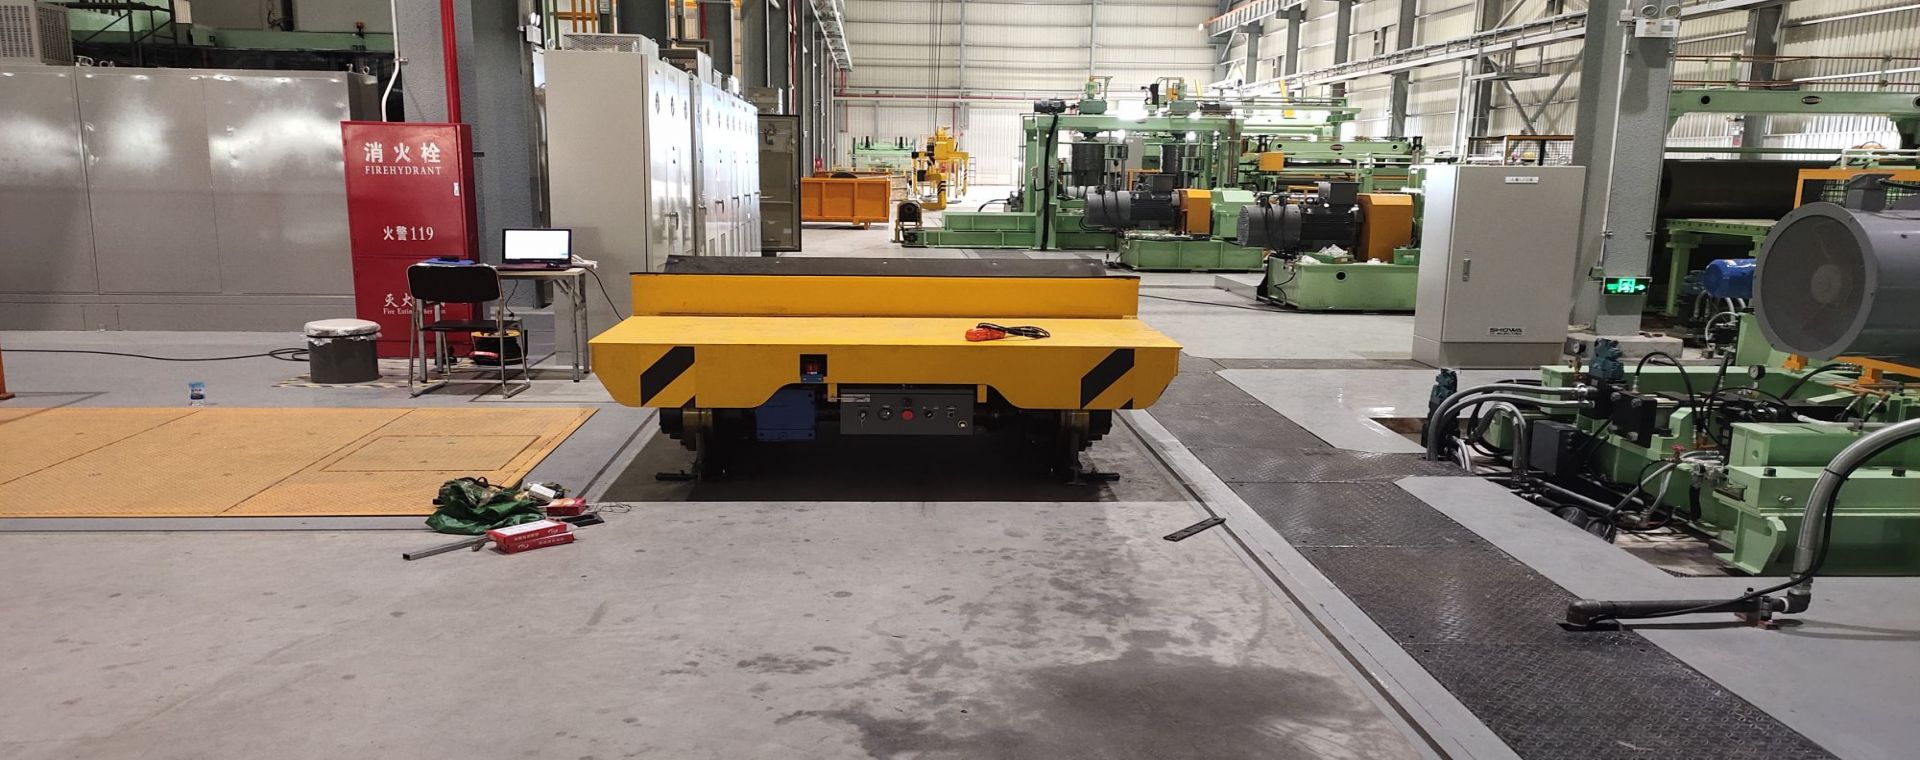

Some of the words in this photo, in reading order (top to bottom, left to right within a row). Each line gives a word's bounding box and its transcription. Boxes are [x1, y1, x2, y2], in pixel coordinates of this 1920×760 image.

[363, 141, 441, 164] 消火栓
[365, 165, 441, 175] FIREHYDRANT
[383, 307, 395, 315] Fire
